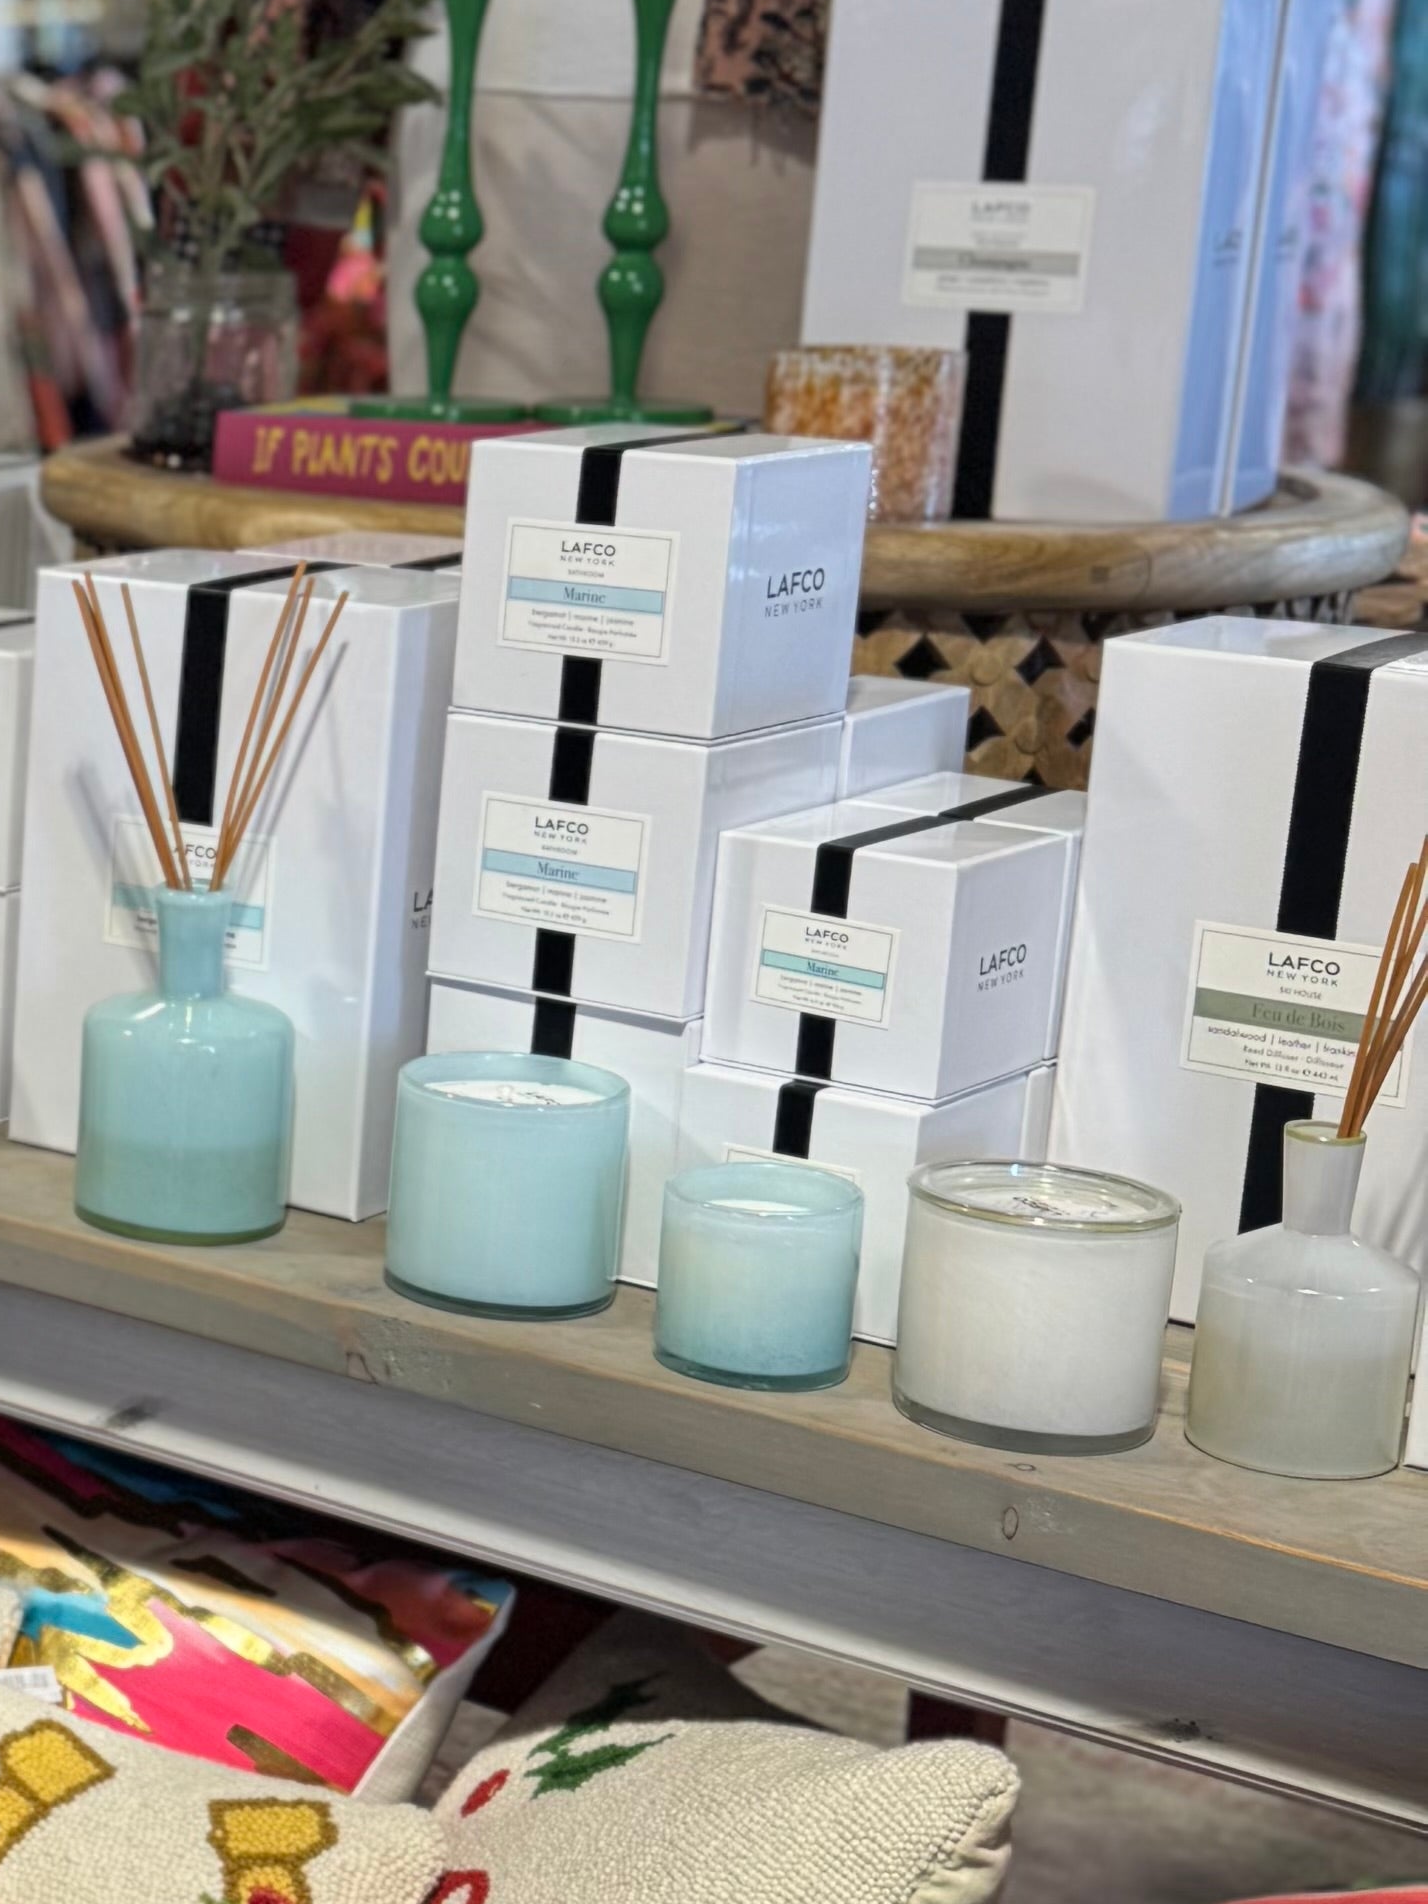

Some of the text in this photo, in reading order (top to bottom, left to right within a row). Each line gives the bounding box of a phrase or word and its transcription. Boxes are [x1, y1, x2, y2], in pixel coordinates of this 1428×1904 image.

[291, 428, 399, 484] PLANTS
[406, 435, 468, 485] COU
[560, 540, 617, 557] LAFCO
[559, 555, 616, 567] NEW YORK
[766, 567, 825, 599] LAFCO
[562, 586, 607, 605] Marine
[764, 597, 824, 618] NEW YORK
[534, 816, 589, 835] LAFCO
[533, 830, 588, 845] NEW YORK
[536, 861, 581, 881] Marine
[804, 926, 850, 944] LAFCO
[806, 961, 840, 977] Marine
[978, 943, 1027, 976] LAFCO
[1268, 951, 1341, 976] LAFCO
[977, 969, 1025, 992] NEW YORK
[1266, 969, 1340, 987] NEW YORK
[1293, 988, 1323, 1001] HOUSE
[1251, 1003, 1346, 1033] Feu de Bois
[1207, 1025, 1267, 1043] sandalwood
[1278, 1036, 1312, 1050] leather
